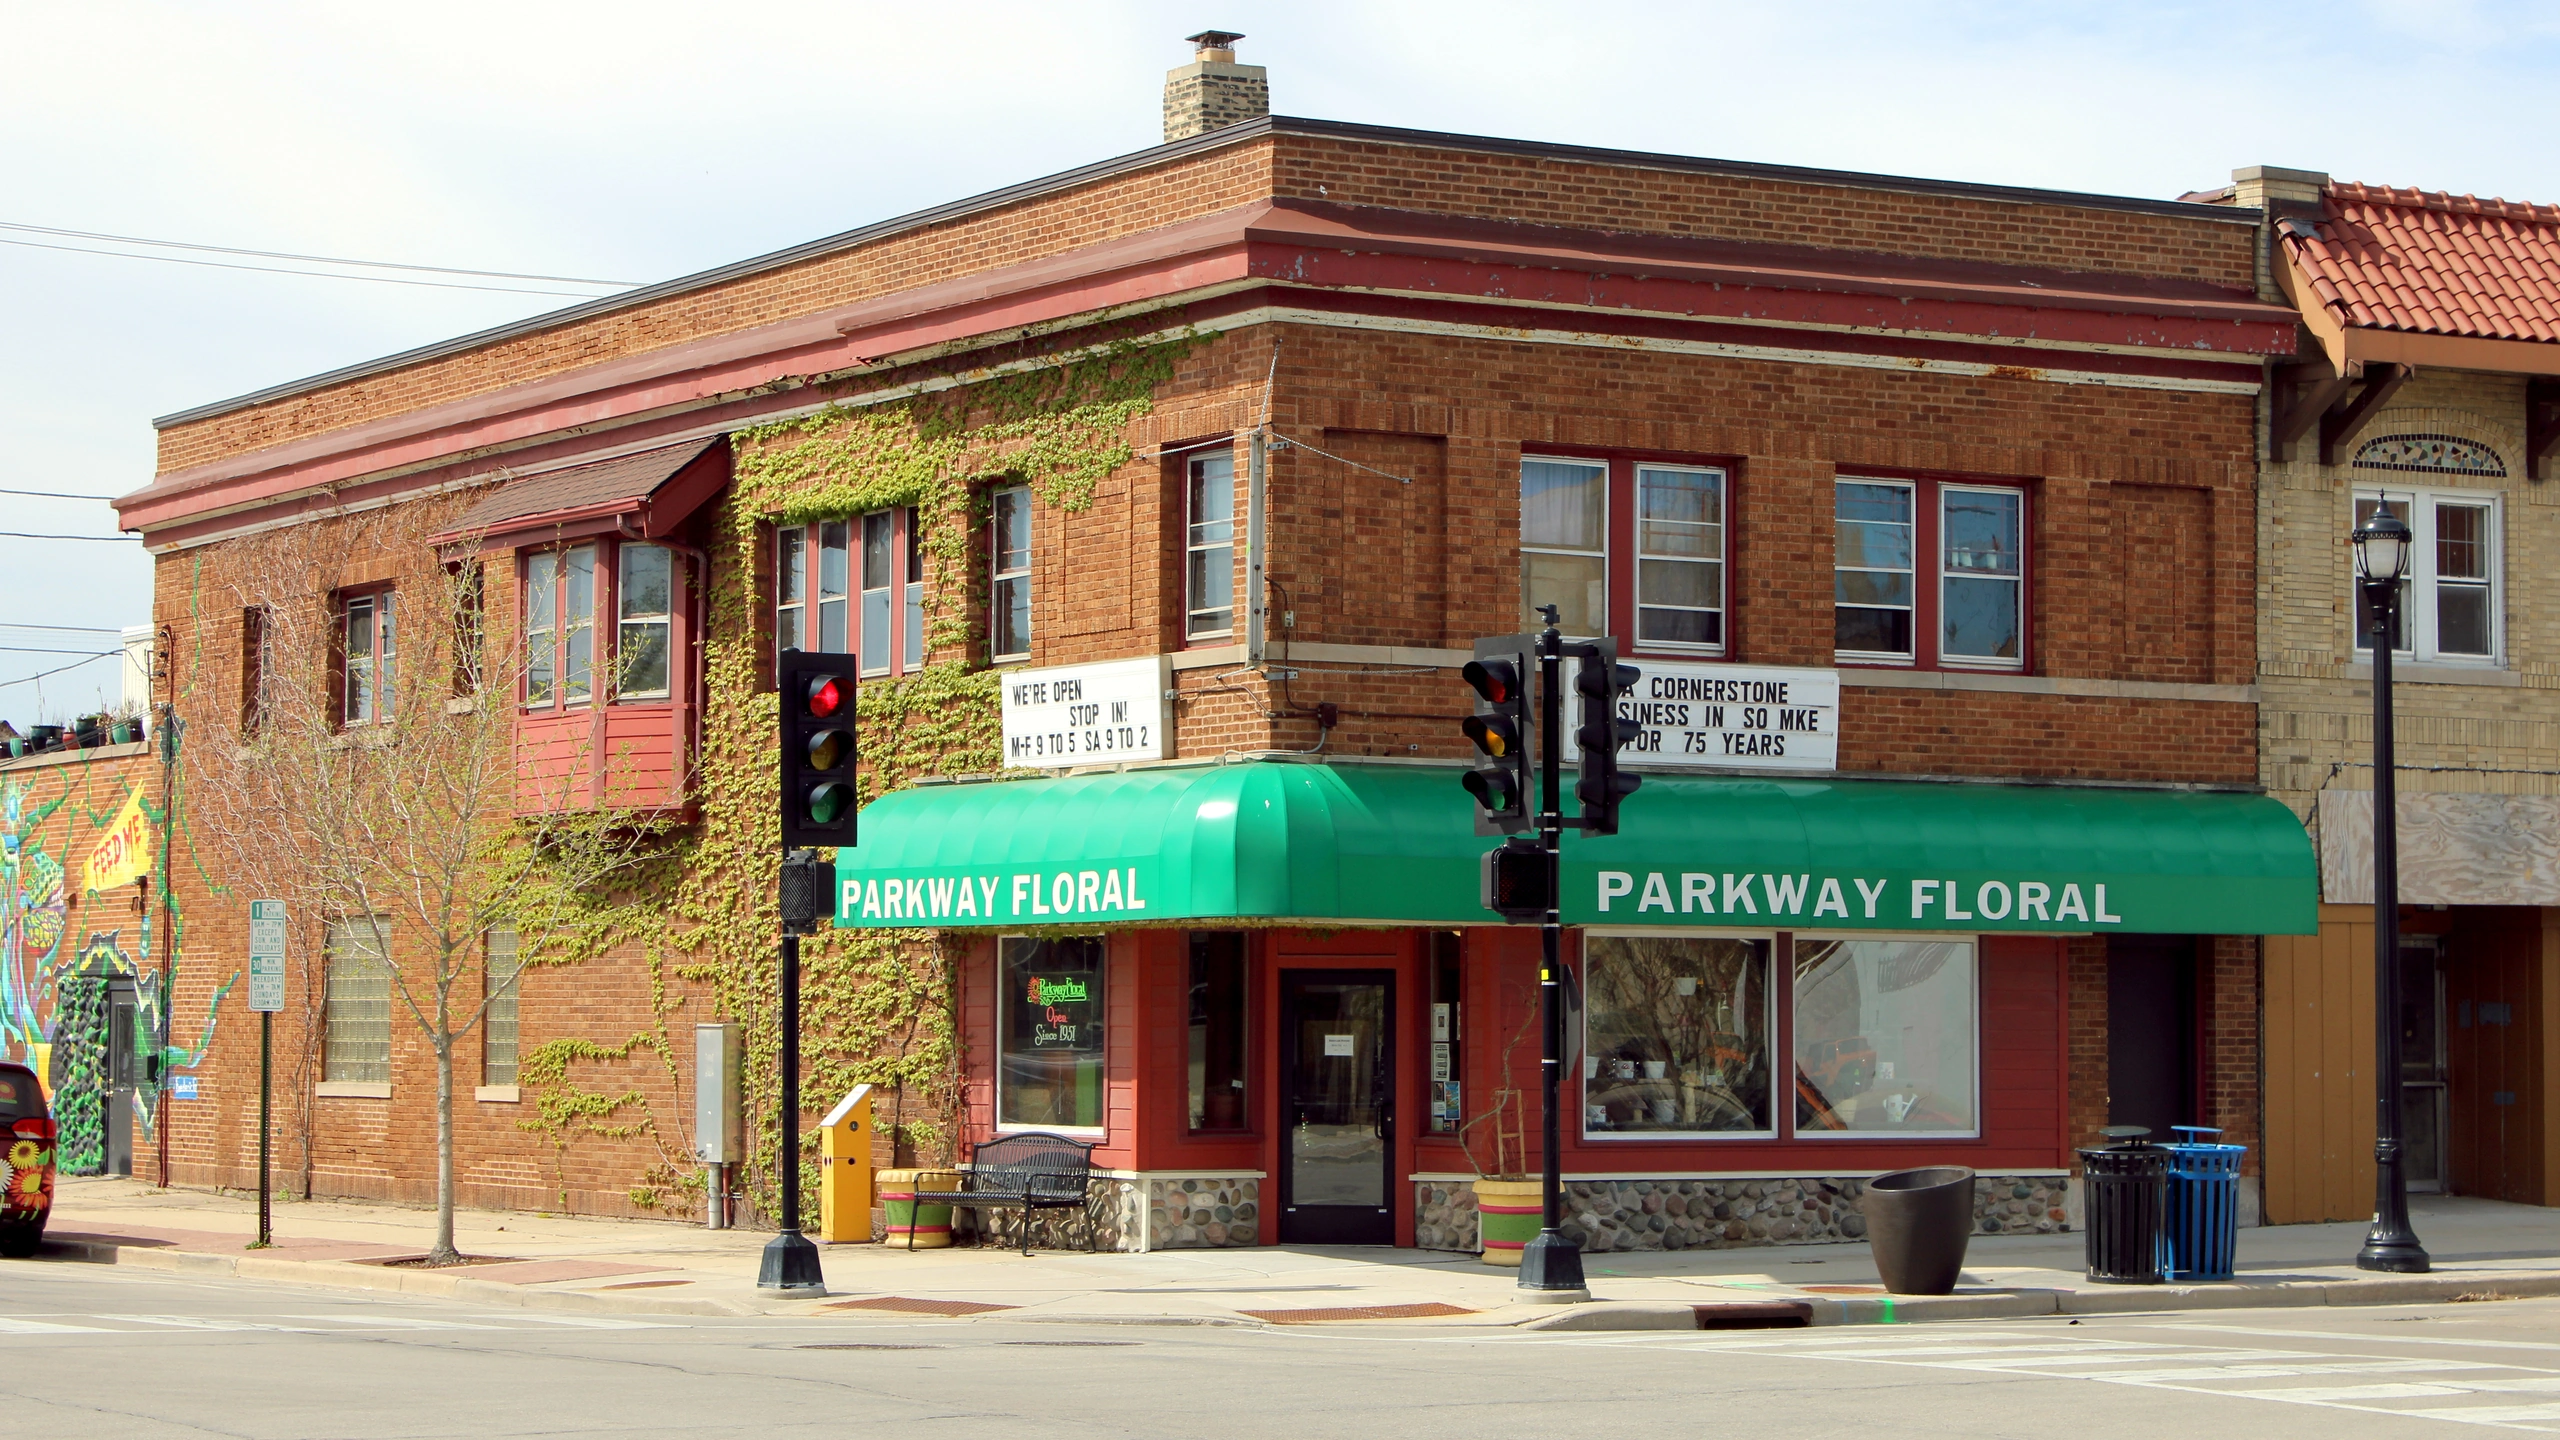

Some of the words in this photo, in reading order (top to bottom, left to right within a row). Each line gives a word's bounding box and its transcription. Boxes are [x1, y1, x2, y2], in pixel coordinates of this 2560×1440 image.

[1013, 683, 1047, 706] WE'RE
[1054, 679, 1082, 702] OPEN
[1651, 677, 1788, 704] CORNERSTONE
[1070, 703, 1099, 726] STOP
[1112, 701, 1128, 723] IN!
[1618, 702, 1689, 726] SINESS
[1705, 706, 1724, 727] IN
[1743, 707, 1768, 729] SO
[1780, 709, 1818, 731] MKE
[1011, 736, 1031, 757] M-F
[1036, 735, 1043, 755] 9
[1049, 733, 1063, 754] TO
[1068, 732, 1075, 752] 5
[1086, 730, 1101, 751] SA
[1106, 729, 1113, 749] 9
[1118, 727, 1133, 749] TO
[1140, 726, 1148, 747] 2
[1684, 731, 1706, 753] 75
[1723, 733, 1785, 756] YEARS
[93, 835, 122, 883] FEED
[122, 814, 141, 856] ME
[842, 876, 999, 919] PARKWAY
[1012, 867, 1146, 916] FLORAL
[1596, 870, 1887, 919] PARKWAY
[1910, 879, 2122, 924] FLORAL
[257, 904, 261, 918] 1
[252, 960, 261, 970] 30
[1040, 978, 1067, 1001] Parkway
[1066, 977, 1086, 997] Floral
[1046, 1006, 1068, 1029] Open
[1035, 1024, 1058, 1046] Since
[1059, 1025, 1076, 1042] 1951
